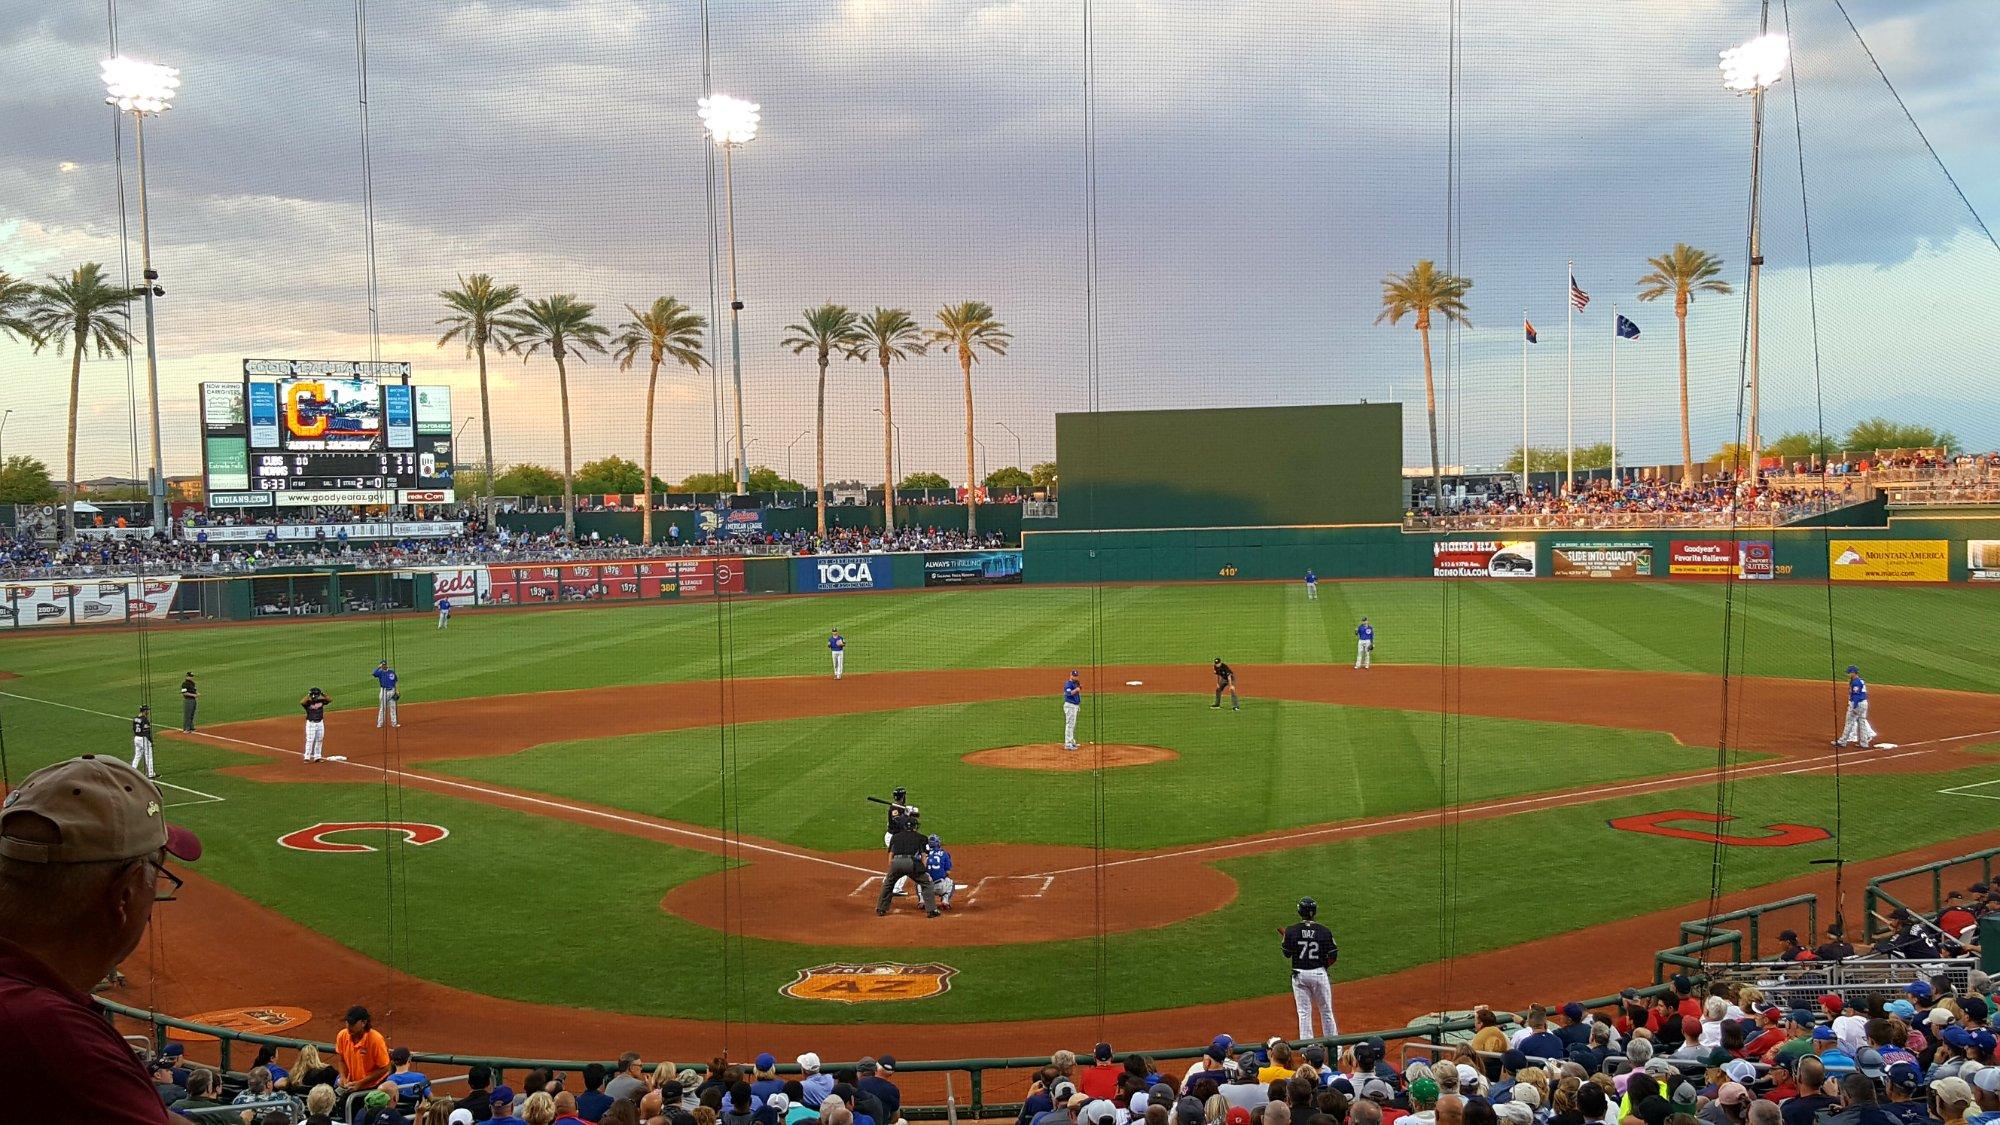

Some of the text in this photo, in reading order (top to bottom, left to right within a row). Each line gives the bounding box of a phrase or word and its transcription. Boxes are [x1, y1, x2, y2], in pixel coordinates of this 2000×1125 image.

[261, 479, 286, 489] 6:33
[214, 495, 268, 503] INDIANS.COM
[288, 493, 384, 505] www.goodyearaz.gov
[1684, 545, 1720, 553] Goodyear's
[1568, 551, 1637, 561] SLIDE INTO QUALITY
[1674, 554, 1702, 562] Favorite
[1865, 551, 1945, 560] MOUNTAIN AMERICA
[817, 563, 873, 584] TOCA
[1865, 569, 1916, 577] www.macu.com
[621, 583, 637, 593] 1972
[1301, 929, 1316, 939] DIAZ
[1297, 941, 1320, 960] 72
